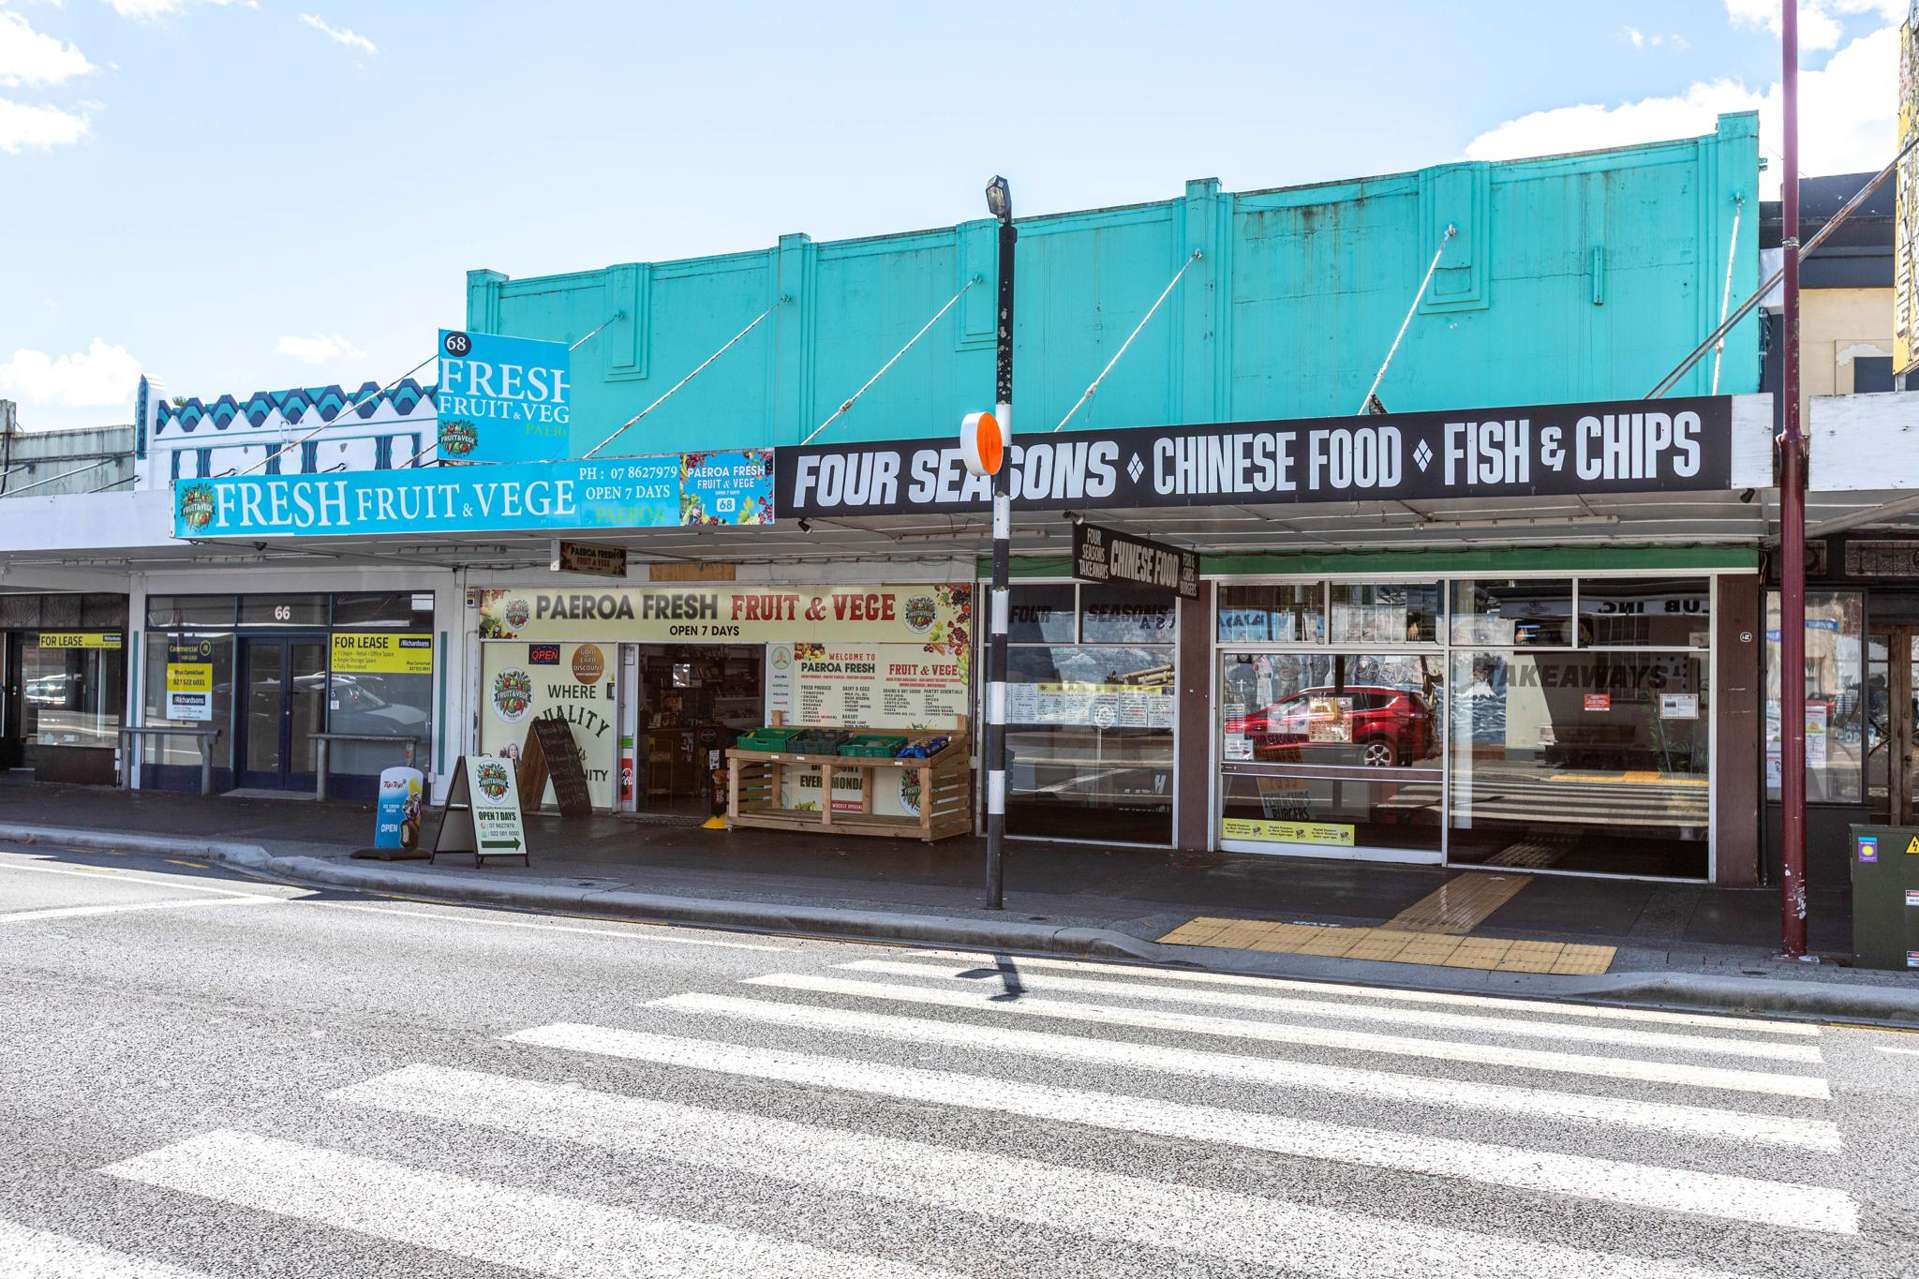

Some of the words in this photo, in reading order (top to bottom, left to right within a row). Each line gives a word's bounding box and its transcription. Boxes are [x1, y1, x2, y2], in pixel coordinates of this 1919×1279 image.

[446, 335, 466, 351] 68
[439, 396, 513, 419] FRUIT
[513, 411, 521, 420] &
[1444, 418, 1530, 485] FISH
[1540, 425, 1566, 472] &
[1576, 411, 1701, 481] CHIPS
[1153, 432, 1297, 495] CHINESE
[1309, 426, 1402, 491] FOOD
[579, 467, 598, 480] PH
[610, 468, 625, 480] 07
[627, 466, 678, 480] 8627979
[688, 467, 730, 478] PAEROA
[733, 465, 766, 476] FRESH
[793, 448, 904, 508] FOUR
[697, 479, 722, 489] FRUIT
[723, 480, 731, 488] &
[733, 478, 755, 488] VEGE
[585, 487, 622, 500] OPEN
[625, 487, 633, 500] 7
[636, 484, 670, 498] DAYS
[214, 480, 351, 528] FRESH
[356, 484, 460, 521] FRUIT
[462, 502, 473, 517] &
[472, 479, 577, 518] VEGE
[719, 499, 733, 510] 68
[1087, 528, 1102, 545] FOUR
[1082, 544, 1105, 562] SEASONS
[1079, 559, 1109, 579] TAKEAWAYS
[1110, 539, 1155, 583] CHINESE
[1154, 549, 1180, 588] FOOD
[275, 605, 291, 620] 66
[536, 594, 635, 620] PAEROA
[642, 594, 718, 620] FRESH
[730, 594, 800, 621] FRUIT
[805, 596, 827, 621] &
[832, 593, 896, 621] VEGE
[1009, 605, 1052, 623] FOUR
[1087, 604, 1169, 622] SEASONS
[669, 625, 699, 636] OPEN
[701, 625, 708, 636] 7
[711, 625, 740, 636] DAYS
[40, 636, 57, 647] FOR
[58, 636, 84, 647] LEASE
[334, 637, 355, 649] FOR
[357, 637, 389, 649] LEASE
[531, 650, 559, 661] OPEN
[828, 653, 863, 661] WELCOME
[867, 653, 876, 661] TO
[801, 662, 842, 673] PAEROA
[845, 662, 876, 673] FRESH
[889, 664, 919, 676] FRUIT
[920, 666, 930, 676] &
[548, 684, 597, 699] WHERE
[540, 704, 610, 738] UALITY
[800, 775, 823, 788] EVER
[478, 811, 496, 821] OPEN
[495, 812, 500, 821] 7
[500, 812, 517, 821] DAYS
[380, 823, 398, 833] OPEN
